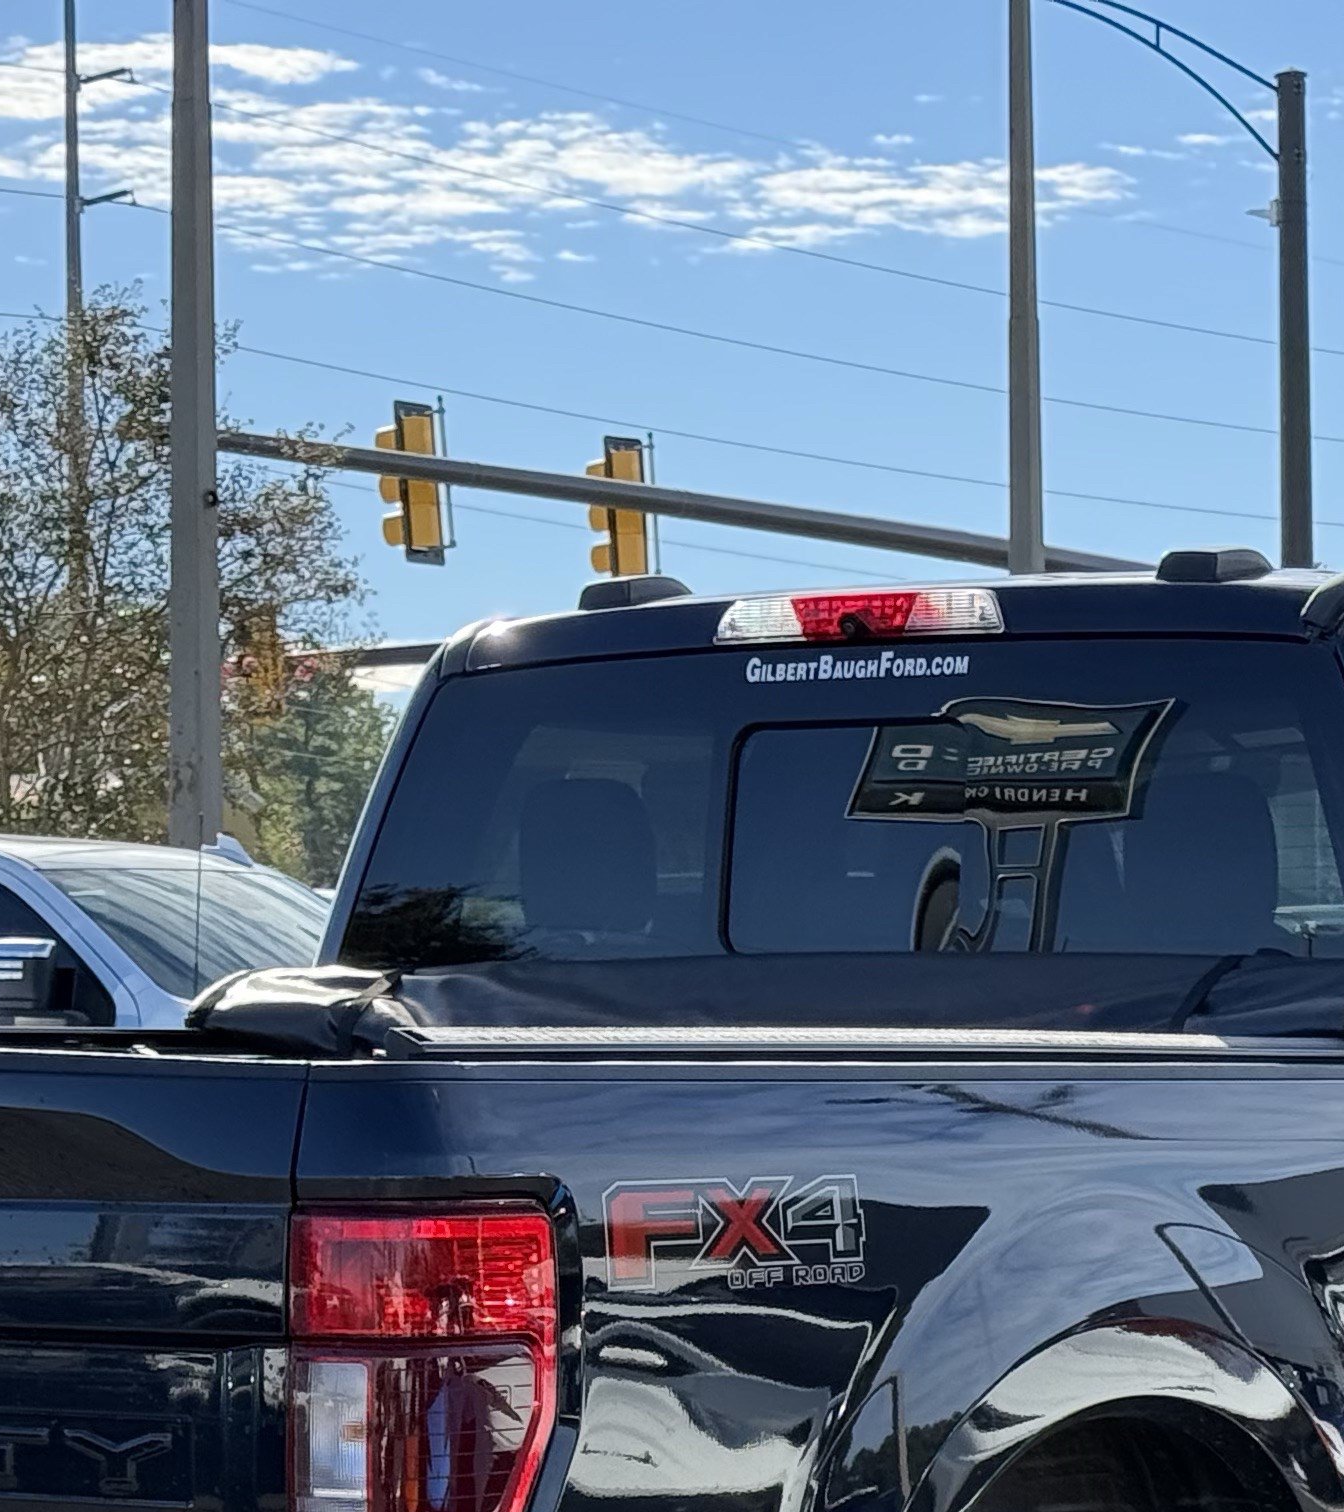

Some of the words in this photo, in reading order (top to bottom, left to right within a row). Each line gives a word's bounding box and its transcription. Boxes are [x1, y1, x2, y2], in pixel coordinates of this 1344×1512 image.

[602, 1174, 866, 1292] FX4
[727, 1266, 784, 1289] OFF
[792, 1263, 866, 1286] ROAD
